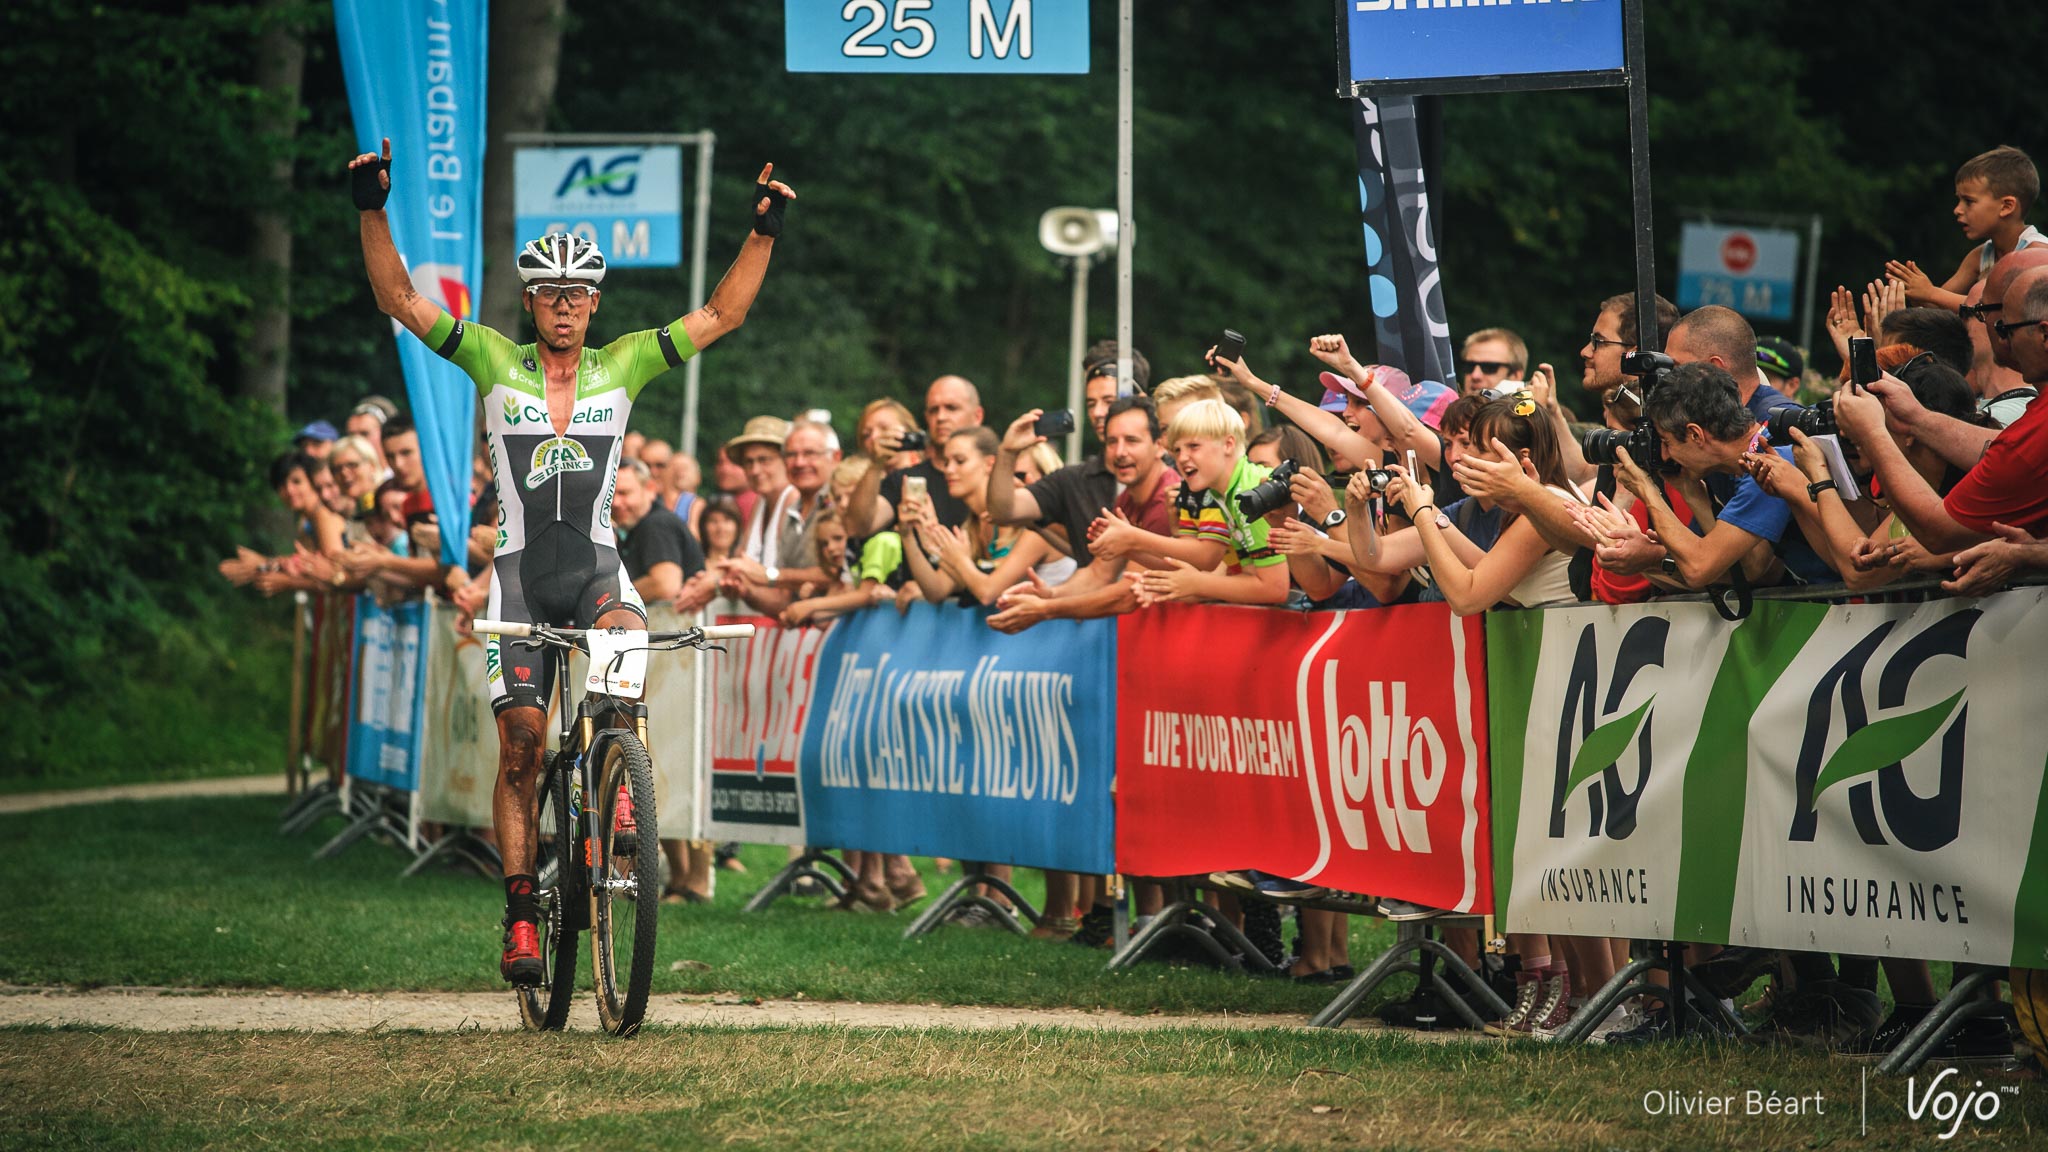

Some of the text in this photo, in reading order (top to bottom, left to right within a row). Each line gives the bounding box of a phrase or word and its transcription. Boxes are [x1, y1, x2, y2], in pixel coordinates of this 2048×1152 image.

[842, 0, 1033, 59] 25 M
[556, 154, 641, 197] AG
[612, 219, 650, 259] M
[523, 405, 613, 424] Crelan
[545, 461, 582, 476] DRINK
[550, 447, 577, 465] AA
[614, 650, 626, 673] 7
[820, 653, 1079, 805] HET LAATSTE NIEUWS
[1144, 710, 1299, 778] LIVE YOUR DREAM
[1549, 616, 1670, 840] AG
[1788, 609, 1984, 852] AG
[1323, 659, 1447, 854] lotto
[1540, 868, 1649, 905] INSURANCE
[1787, 875, 1969, 924] INSURANCE
